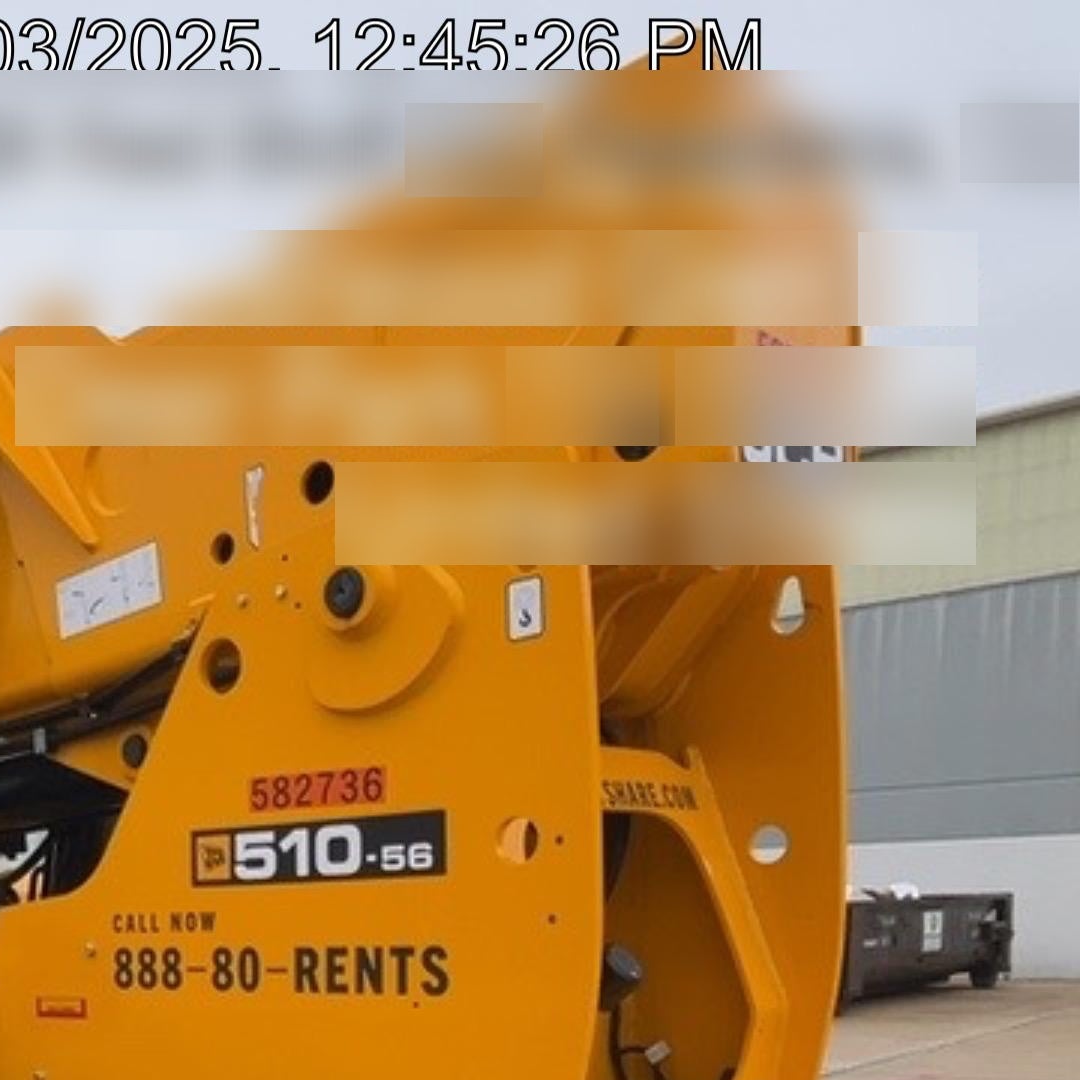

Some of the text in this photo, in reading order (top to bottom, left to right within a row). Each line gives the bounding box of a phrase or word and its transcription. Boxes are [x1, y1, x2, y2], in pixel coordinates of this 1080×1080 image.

[251, 767, 384, 811] 582736
[601, 779, 699, 810] SHARE.COM
[233, 823, 434, 881] 510-56
[112, 911, 218, 934] CALL NOW
[113, 945, 450, 997] 888-80-RENTS
